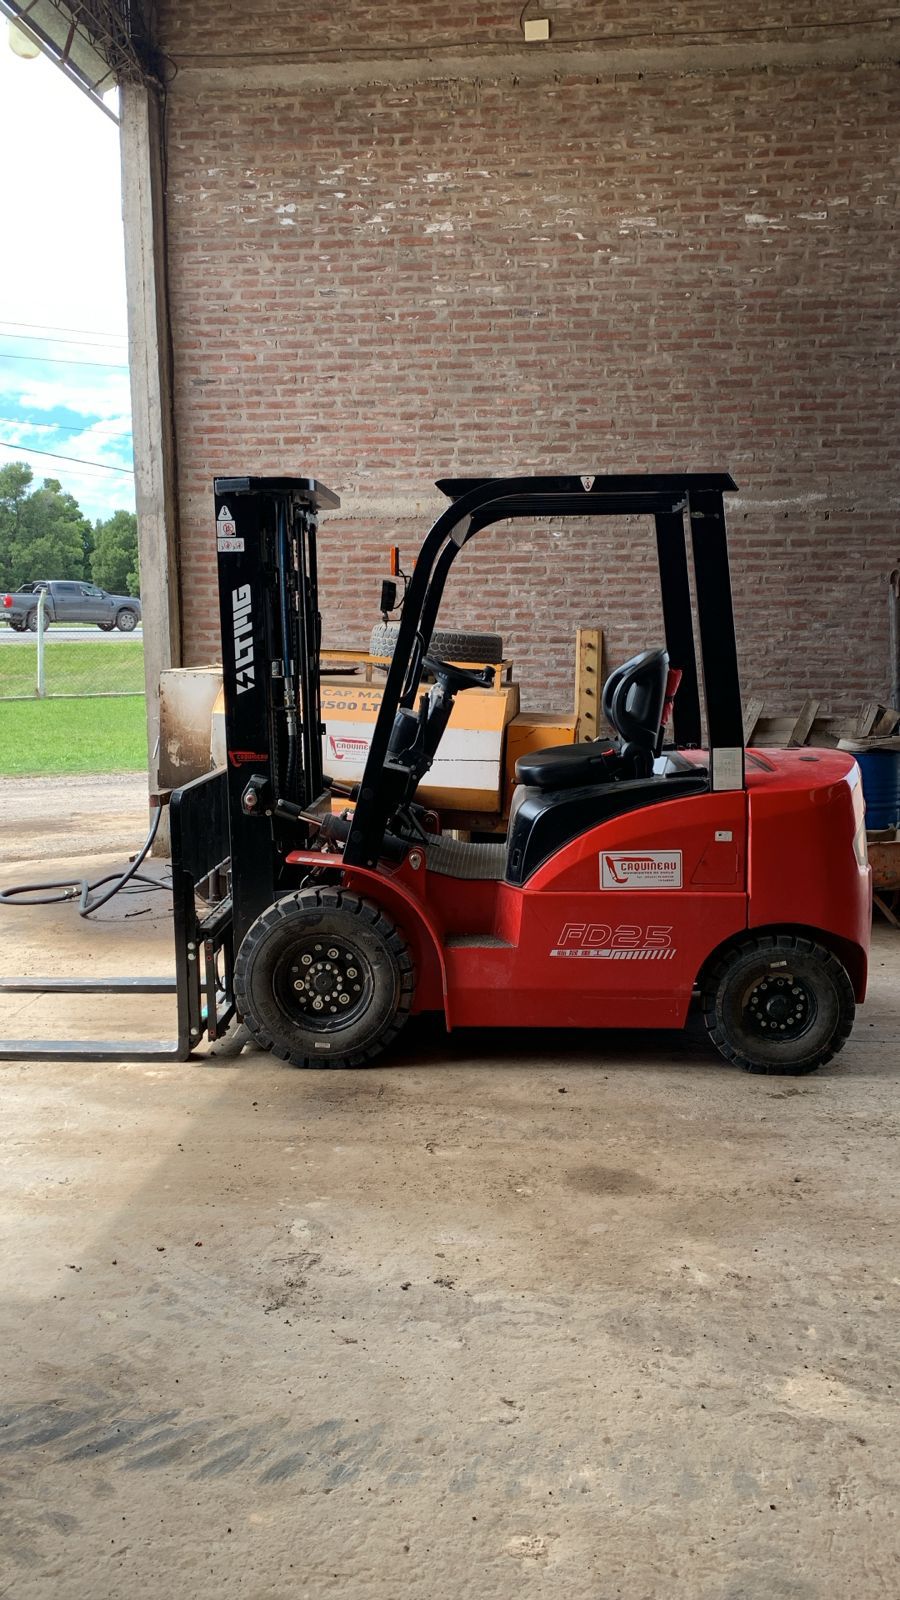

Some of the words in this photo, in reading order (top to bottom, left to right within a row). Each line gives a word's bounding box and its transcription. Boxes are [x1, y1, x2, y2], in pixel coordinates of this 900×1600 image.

[232, 584, 254, 670] LTMG
[358, 691, 383, 699] MA
[361, 703, 382, 712] LT
[336, 742, 369, 751] CAQUINE
[620, 862, 677, 871] CAQUINEAU
[557, 923, 673, 948] FD25
